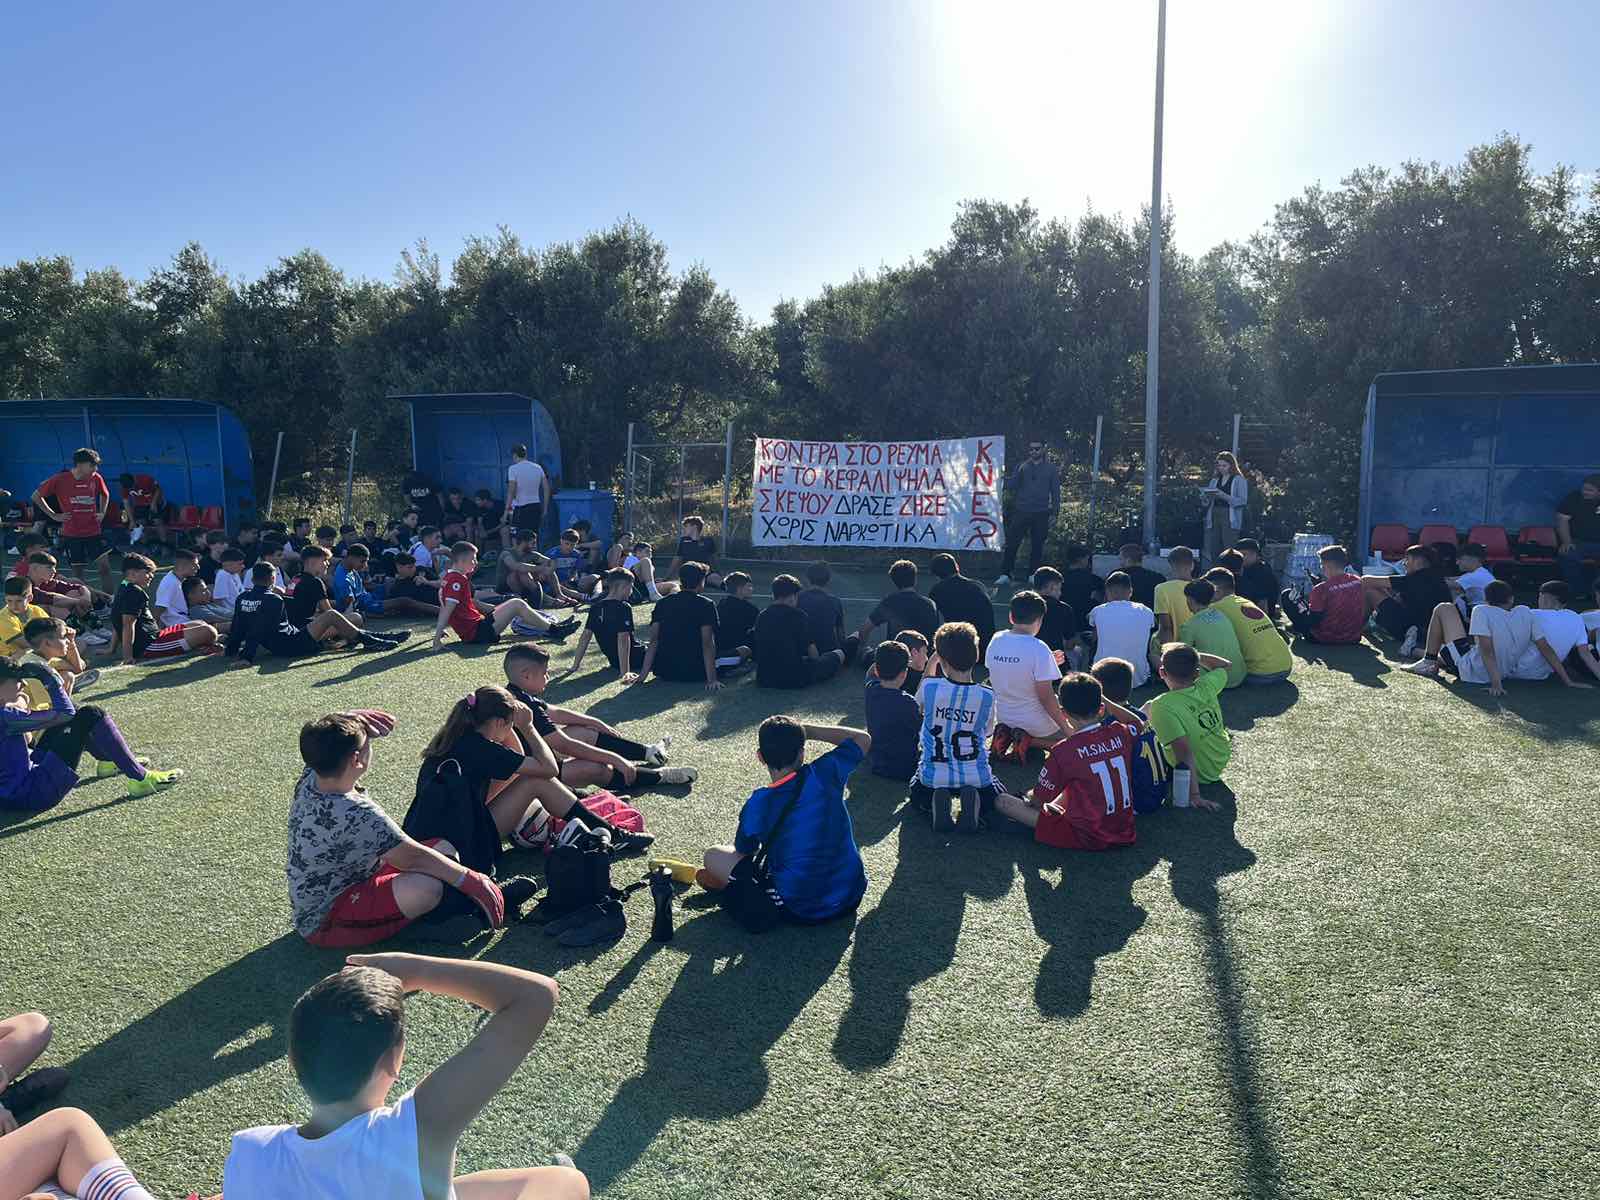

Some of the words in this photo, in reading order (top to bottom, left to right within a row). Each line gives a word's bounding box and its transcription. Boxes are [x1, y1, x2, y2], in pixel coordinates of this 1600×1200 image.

[761, 440, 839, 466] ΚΟΝΤΡΑ
[845, 444, 882, 466] ΣΤΟ
[888, 443, 943, 465] ΡΕΥΜΑ
[759, 465, 785, 484] ΜΕ
[792, 466, 817, 487] ΤΟ
[760, 489, 834, 515] ΣΚΕΨΟΥ
[835, 495, 896, 517] ΔΡΑΣΕ
[899, 495, 948, 516] ΖΗΣΕ
[761, 515, 819, 541] ΧΩΡΙΣ
[824, 521, 937, 544] ΝΑΡΚΩΤΙΚΑ
[993, 655, 1021, 664] MATEO
[936, 706, 976, 724] MESSI
[929, 725, 980, 762] 10
[1077, 735, 1122, 759] M.SALAH
[1089, 754, 1131, 815] 11
